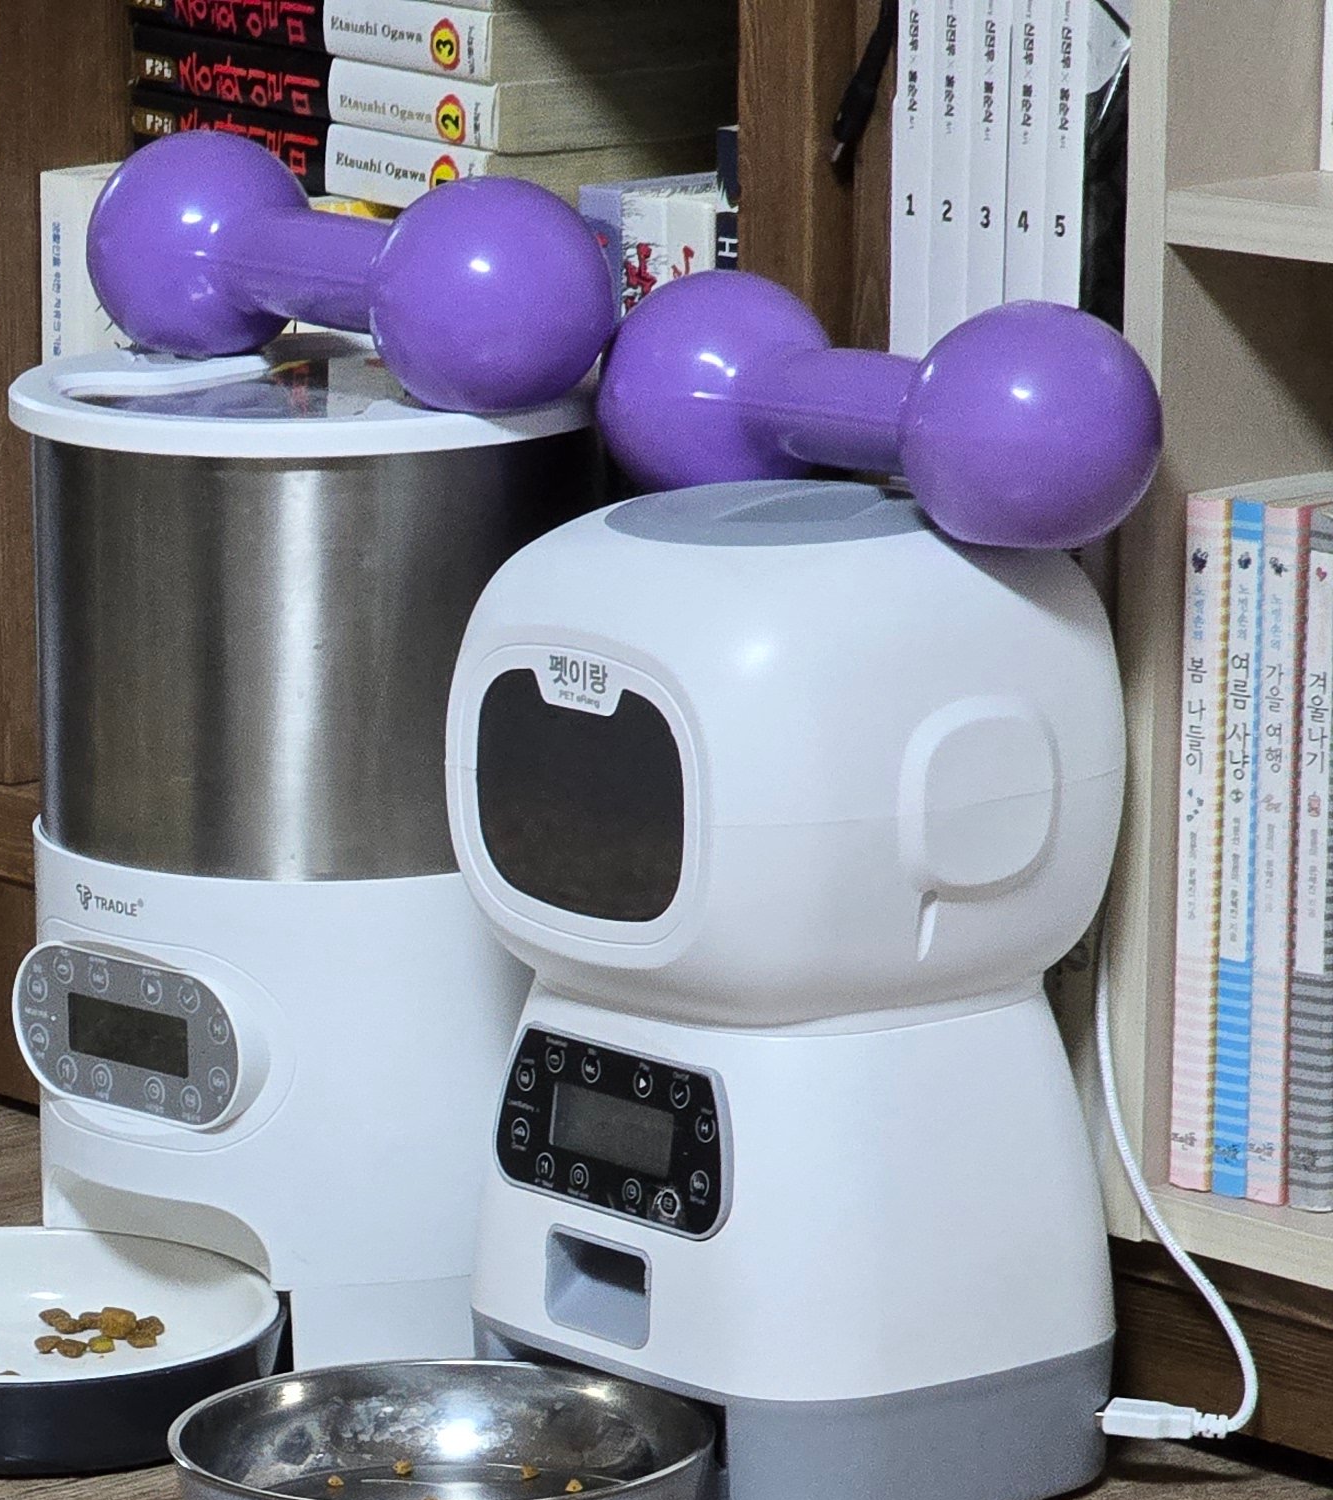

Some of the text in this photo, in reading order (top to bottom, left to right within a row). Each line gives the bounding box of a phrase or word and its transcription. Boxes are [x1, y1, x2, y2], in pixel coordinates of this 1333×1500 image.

[330, 15, 423, 43] Etsushi Ogawa
[339, 94, 432, 122] Etsushi Ogawa
[335, 152, 426, 182] Etsushi Ogawa
[906, 193, 915, 215] 1
[942, 199, 952, 222] 2
[980, 206, 991, 228] 3
[1017, 210, 1029, 232] 4
[1054, 214, 1066, 237] 5
[548, 654, 609, 695] 펫이랑
[1187, 657, 1207, 684] 봄
[1230, 653, 1251, 711] 여름
[1265, 663, 1284, 713] 가을
[1185, 698, 1207, 774] 나들이
[1305, 671, 1330, 775] 겨울나기
[1227, 721, 1251, 782] 사냥
[1263, 722, 1284, 774] 여행
[94, 895, 138, 917] TRADLE
